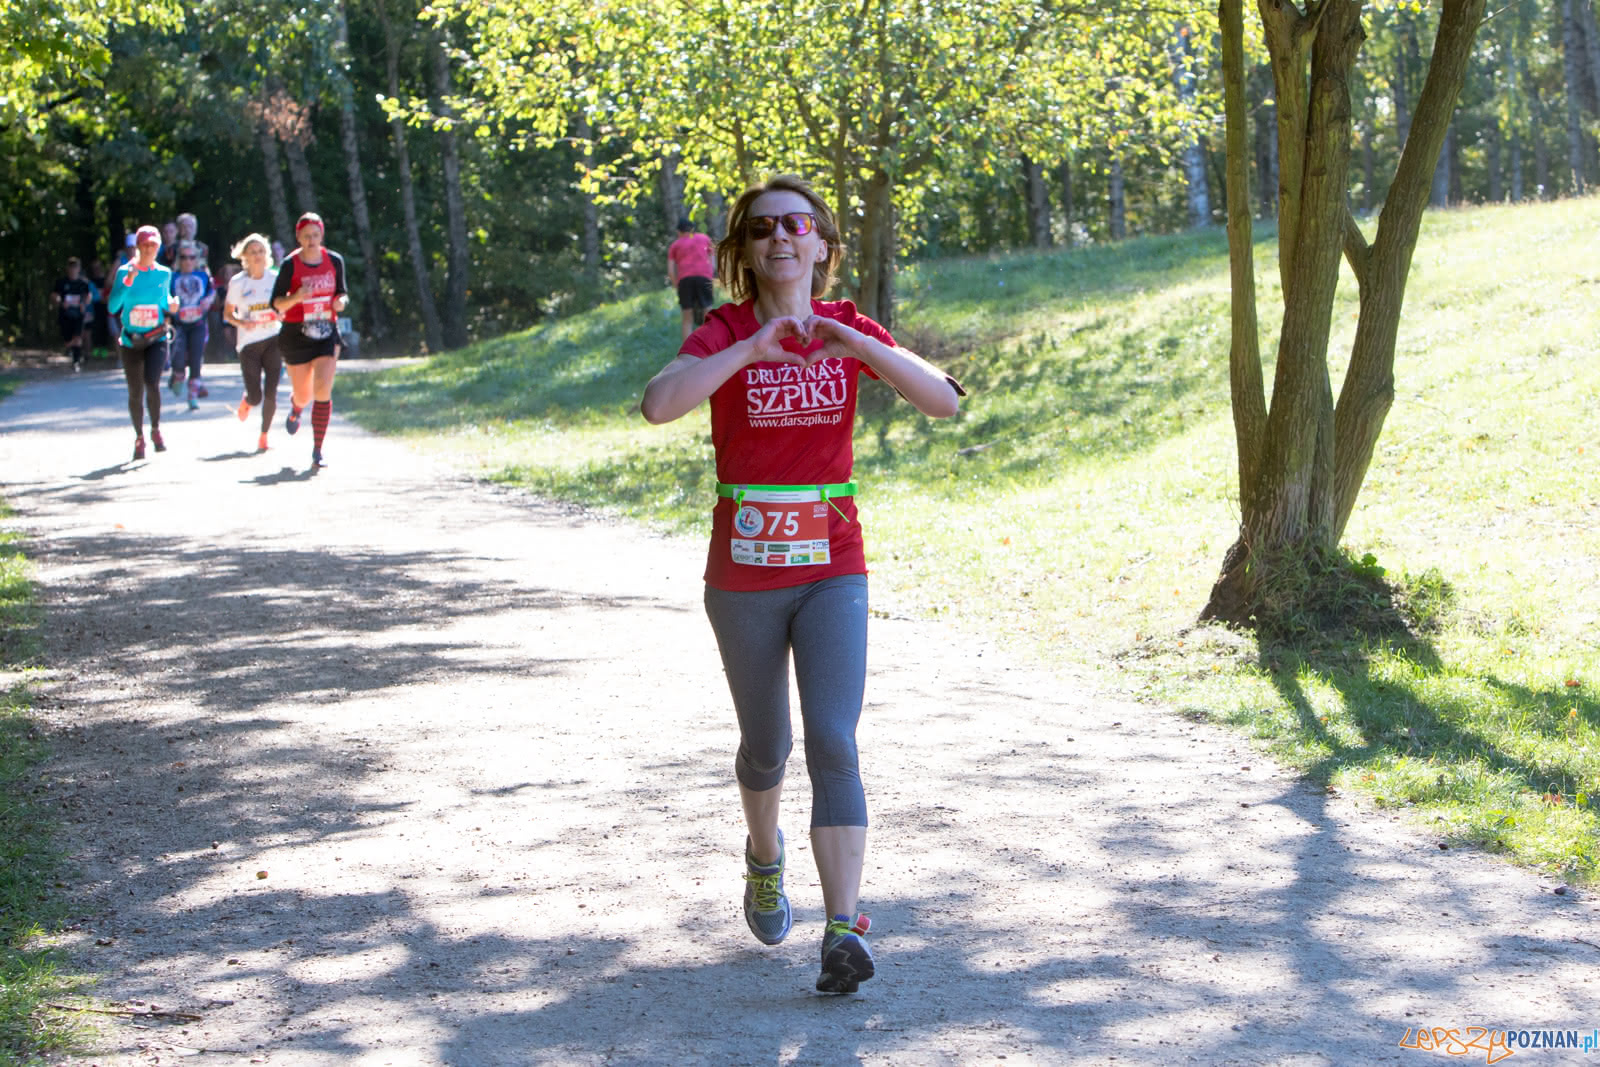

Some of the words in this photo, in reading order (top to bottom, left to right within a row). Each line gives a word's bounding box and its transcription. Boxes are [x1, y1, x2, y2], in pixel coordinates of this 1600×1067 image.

[747, 363, 831, 385] DRUŻYNA
[747, 378, 847, 414] SZPIKU
[749, 411, 842, 428] www.darszpiku.pl
[767, 511, 800, 536] 75
